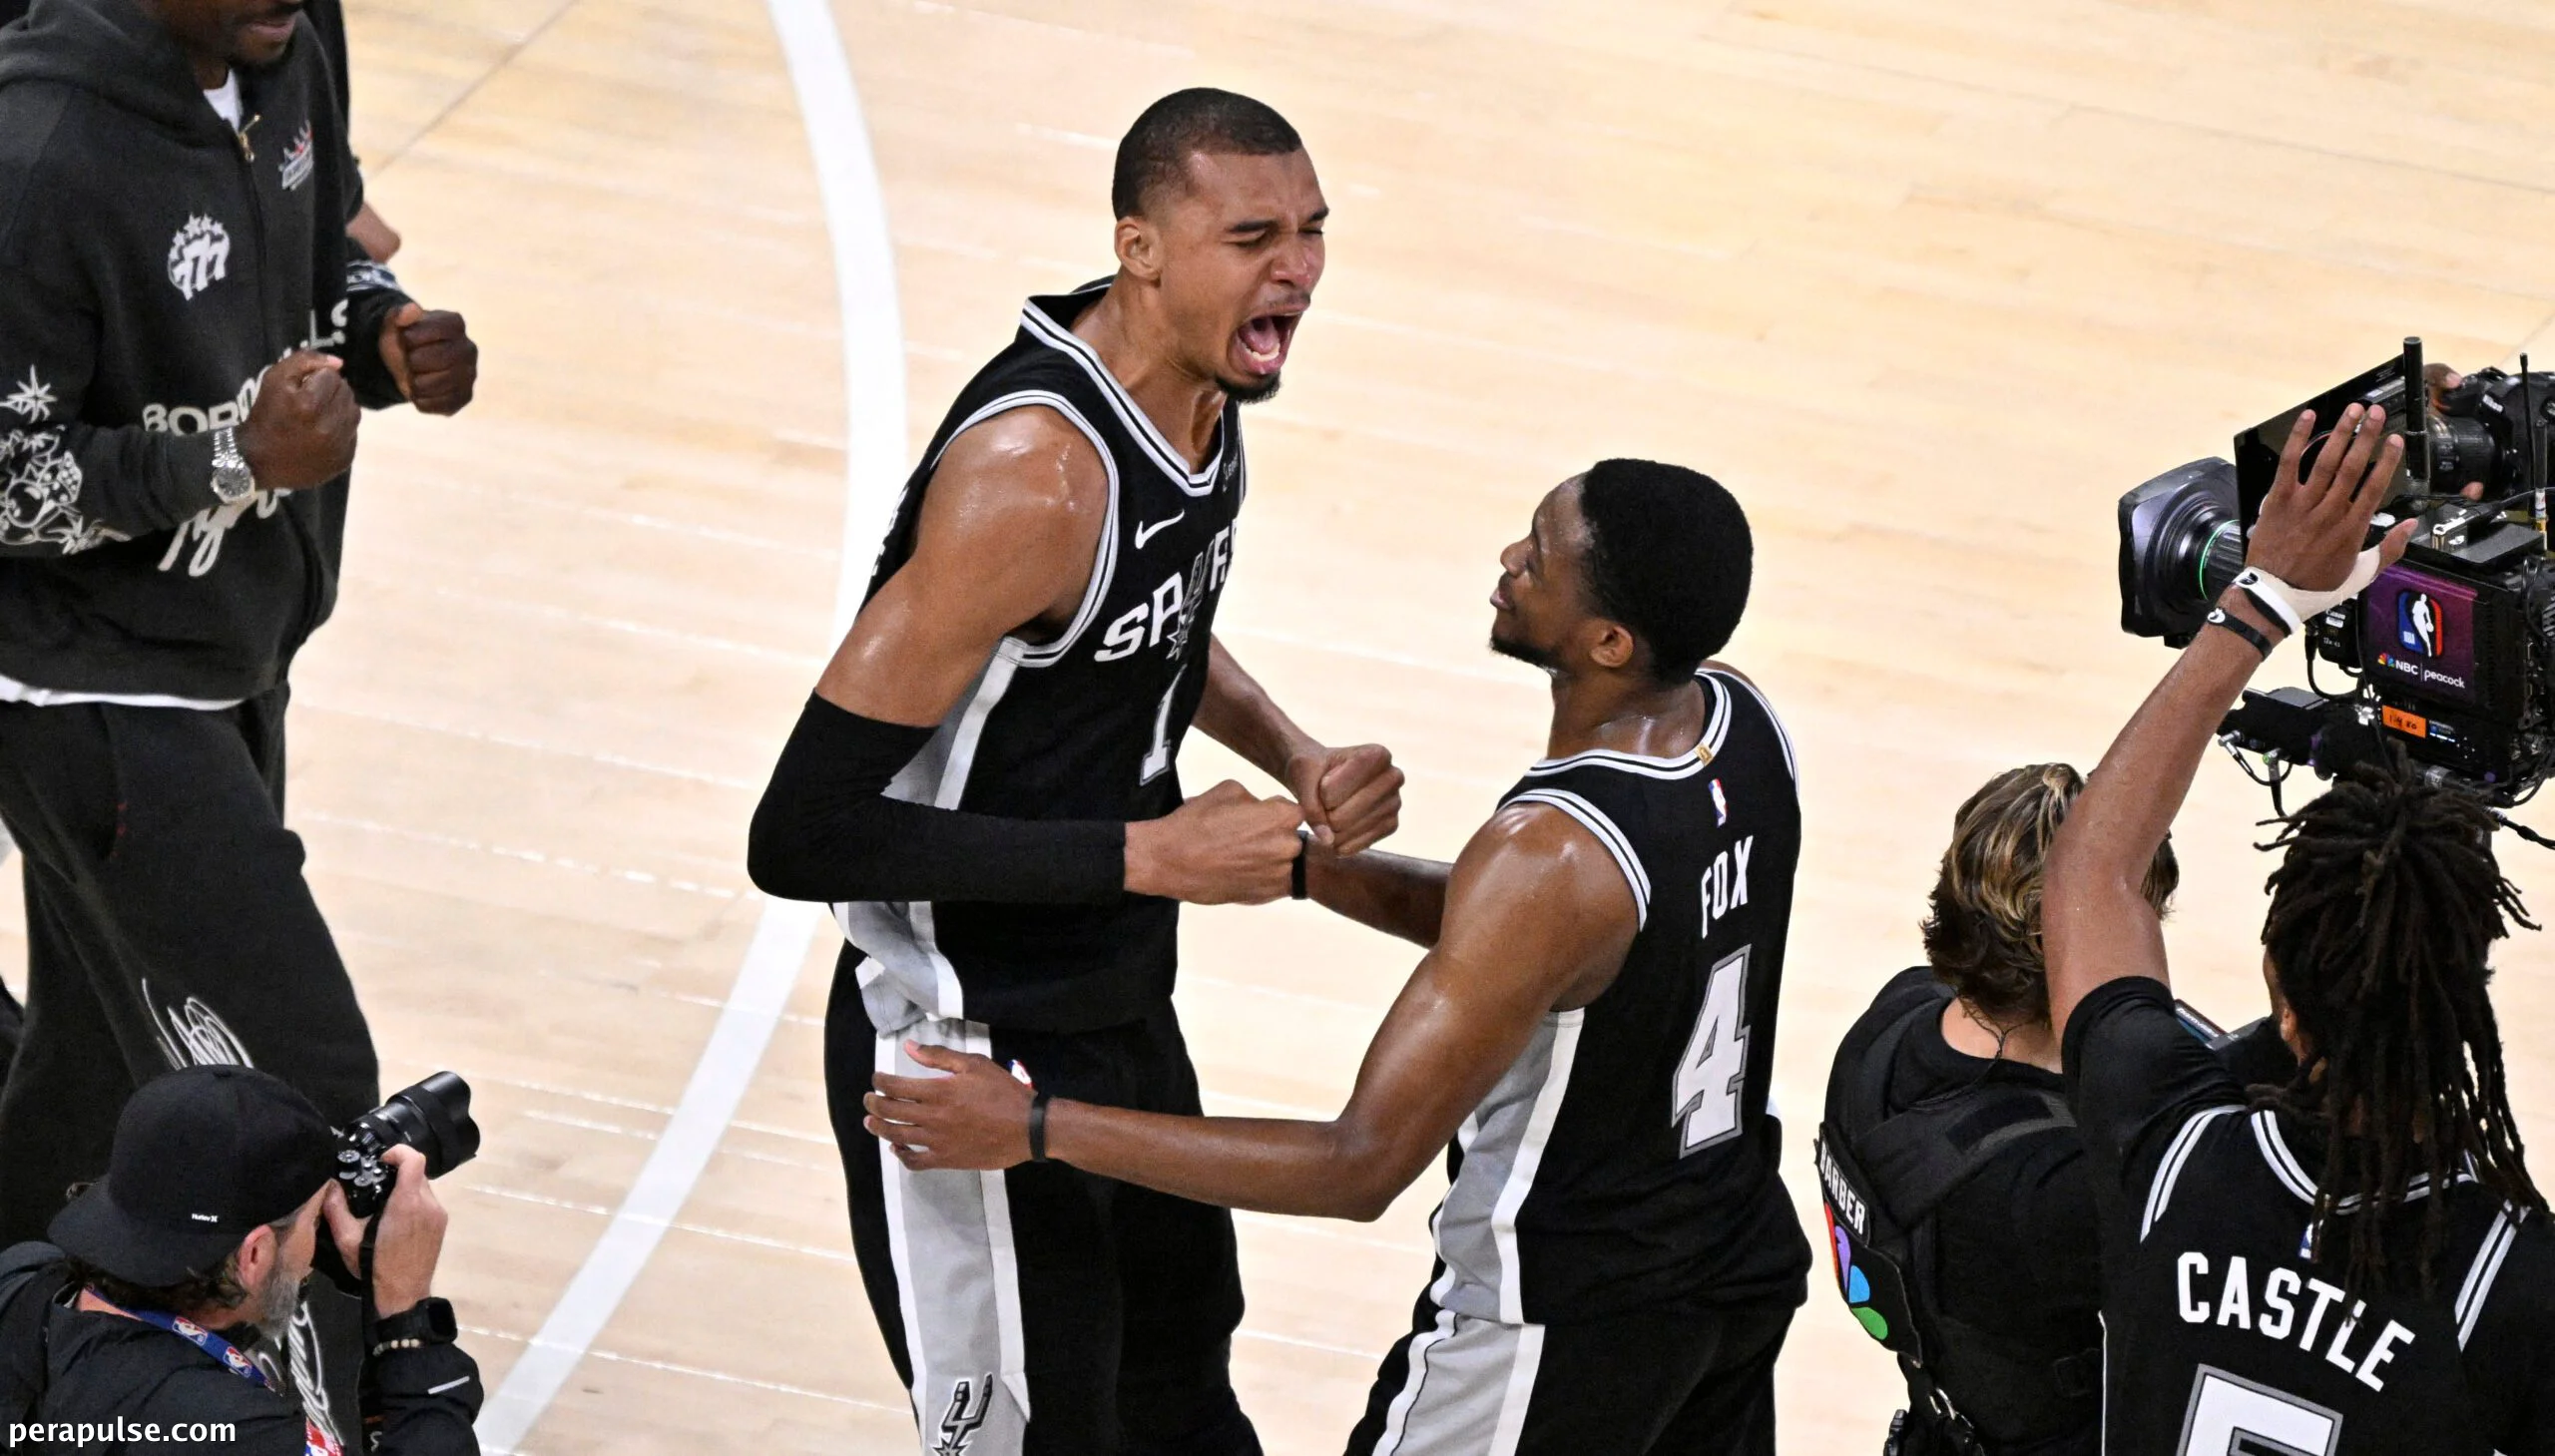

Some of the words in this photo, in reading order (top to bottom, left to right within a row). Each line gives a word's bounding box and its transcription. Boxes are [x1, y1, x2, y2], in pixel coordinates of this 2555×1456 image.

[1139, 663, 1188, 786] 1
[2395, 660, 2419, 676] NBC
[2424, 669, 2465, 689] peacock
[1701, 834, 1755, 940] FOX
[1672, 943, 1752, 1159] 4
[1819, 1140, 1866, 1235] BARBER
[2177, 1251, 2416, 1393] CASTLE
